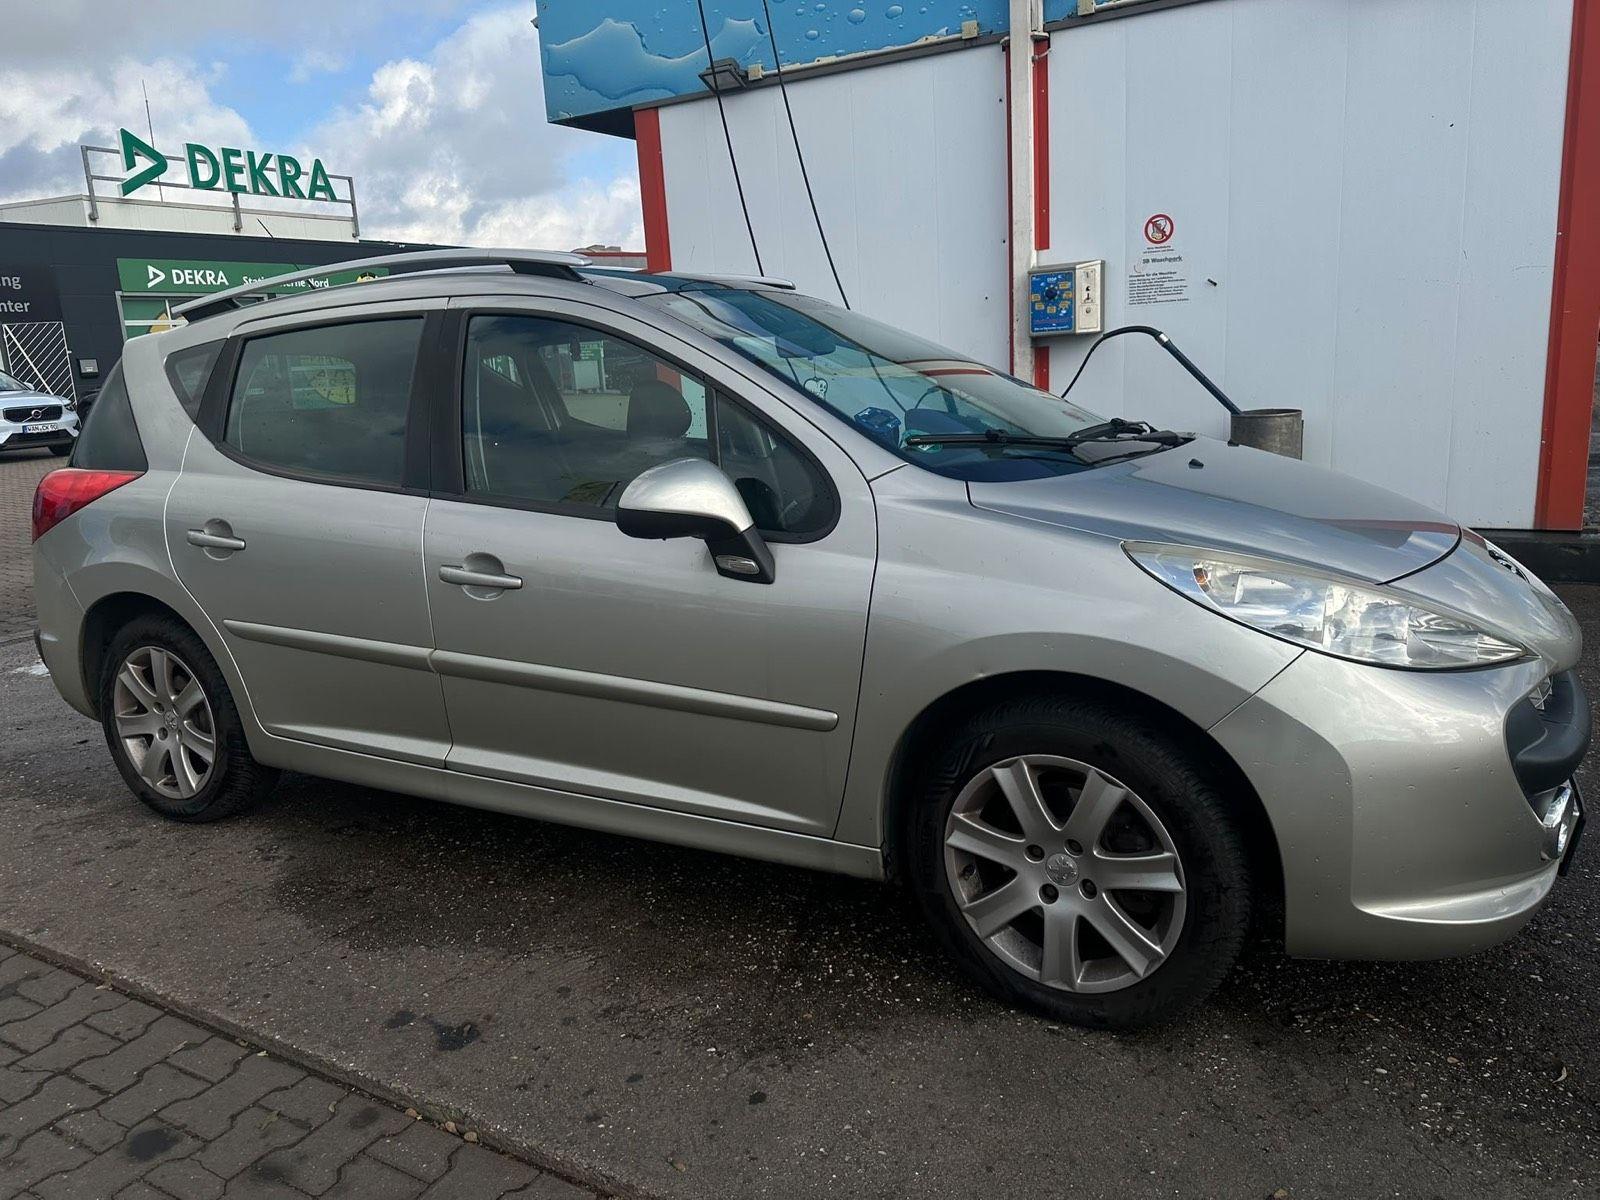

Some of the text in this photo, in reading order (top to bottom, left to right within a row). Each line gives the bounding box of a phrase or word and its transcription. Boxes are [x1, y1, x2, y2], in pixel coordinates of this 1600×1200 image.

[183, 142, 338, 201] DEKRA
[0, 276, 22, 290] ng
[171, 268, 230, 286] DEKRA
